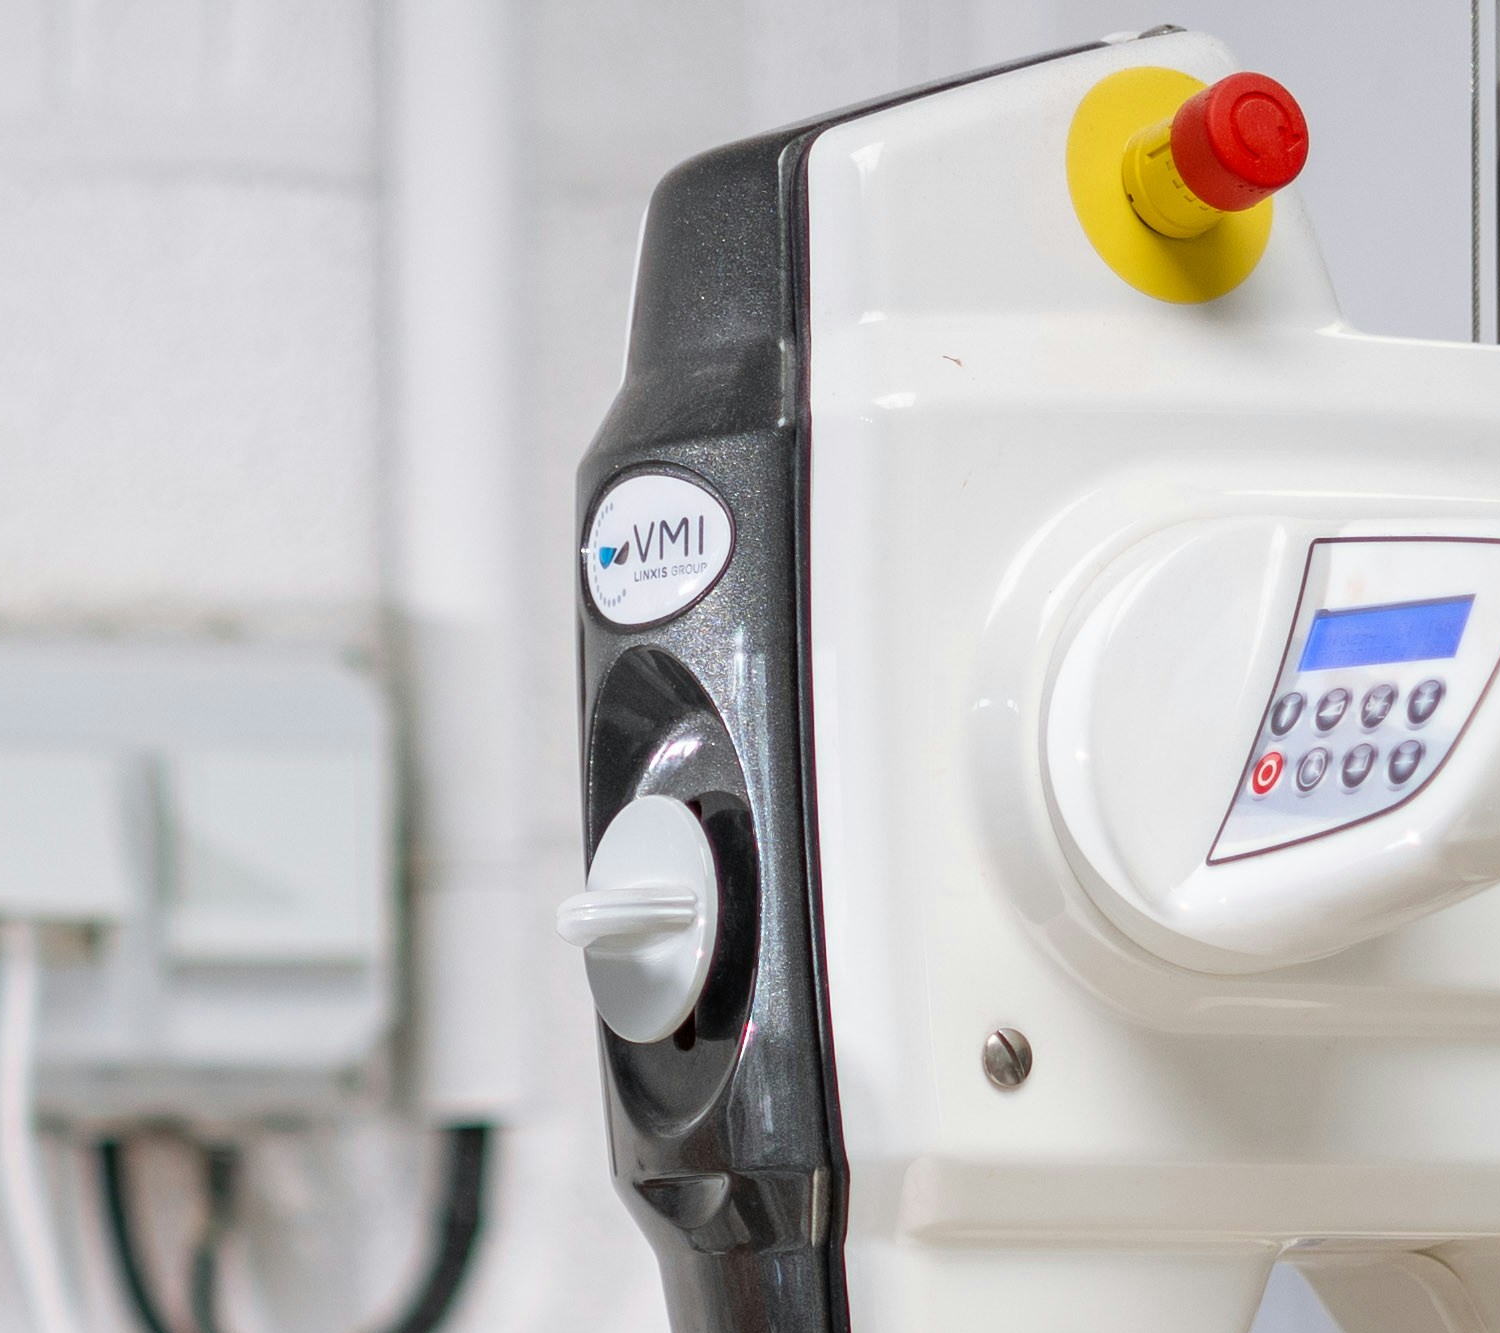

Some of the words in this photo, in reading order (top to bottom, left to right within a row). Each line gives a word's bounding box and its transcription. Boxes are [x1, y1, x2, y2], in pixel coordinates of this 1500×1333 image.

[634, 515, 704, 563] VMI
[634, 566, 668, 582] LINXIS
[671, 562, 708, 577] GROUP
